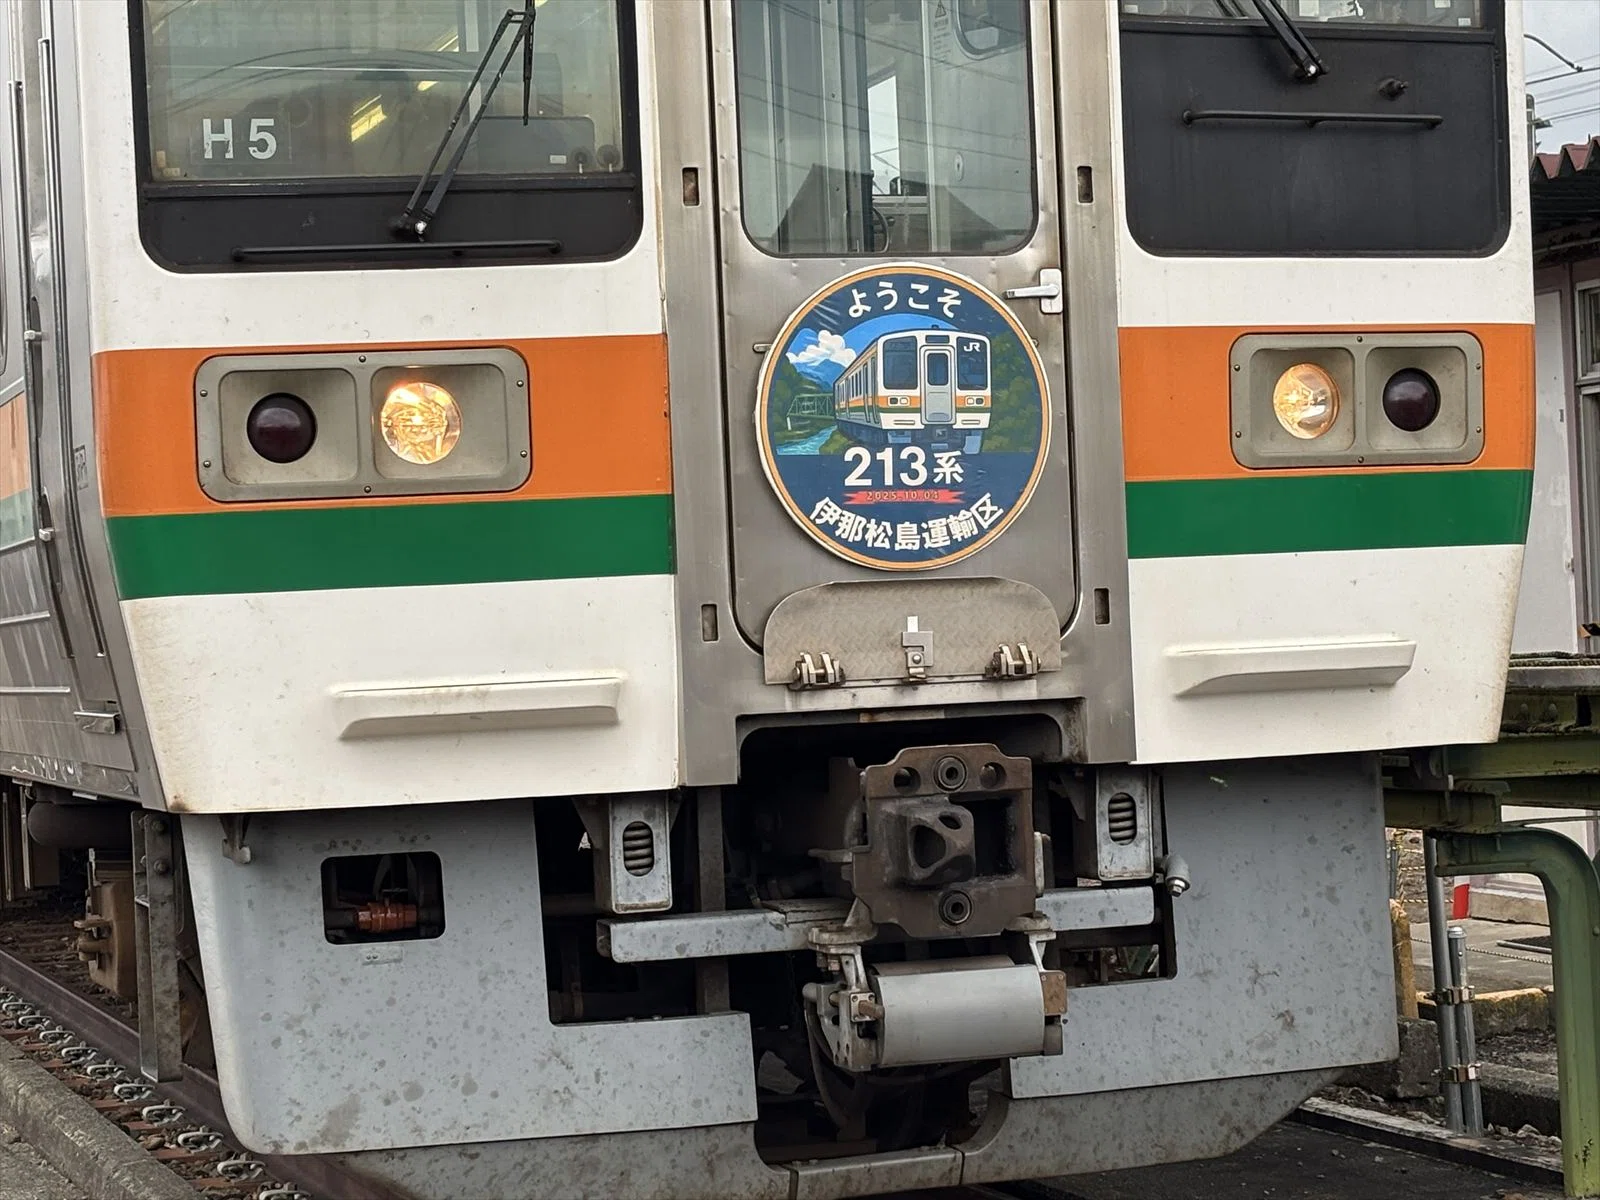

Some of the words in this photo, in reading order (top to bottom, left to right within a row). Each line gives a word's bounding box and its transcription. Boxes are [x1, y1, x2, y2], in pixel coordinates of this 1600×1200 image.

[848, 281, 962, 318] ようこそ
[963, 342, 981, 353] JR
[844, 447, 964, 487] 213系
[810, 492, 1004, 551] 伊那松島運輸区
